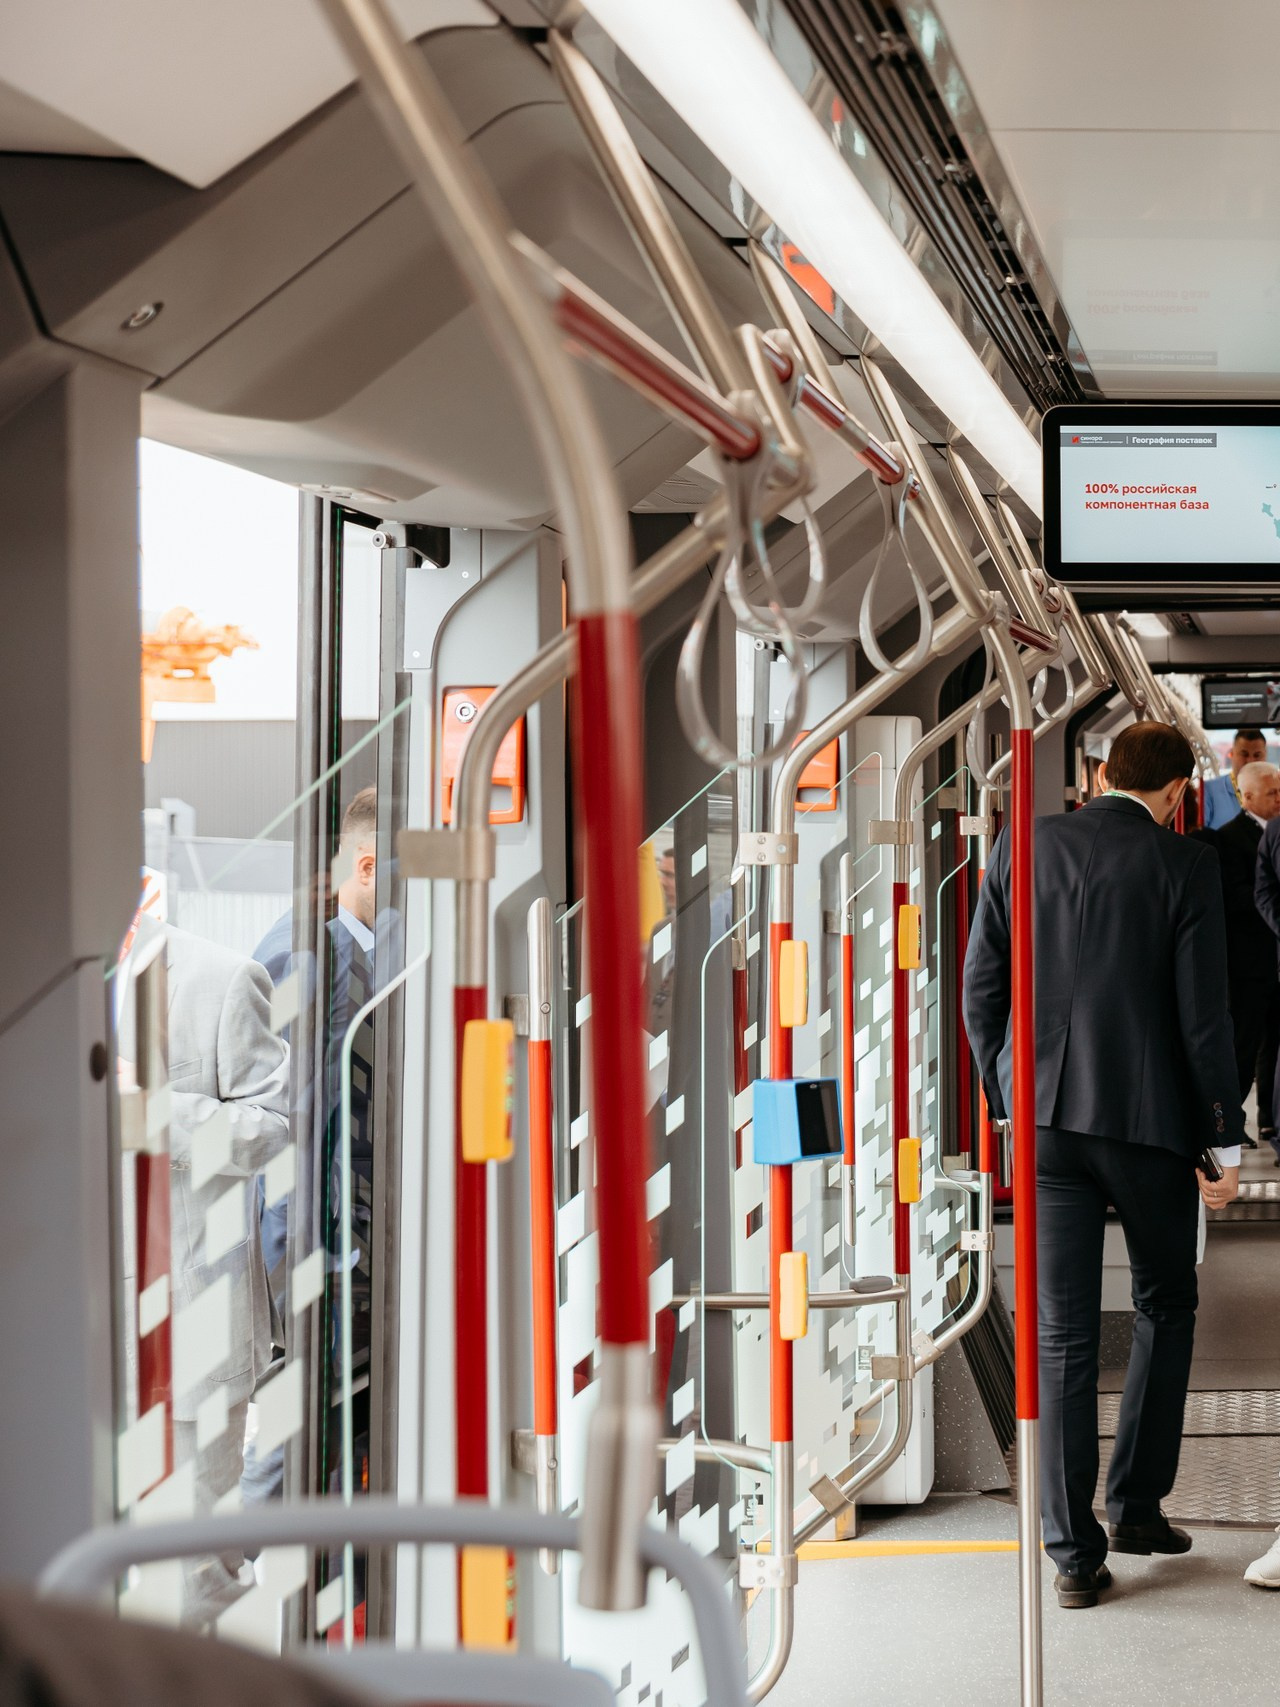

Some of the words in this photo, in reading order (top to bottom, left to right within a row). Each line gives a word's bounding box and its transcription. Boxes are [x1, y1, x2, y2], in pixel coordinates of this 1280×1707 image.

[1132, 436, 1174, 445] География
[1085, 484, 1119, 494] 100%
[1122, 484, 1197, 496] российская
[1085, 501, 1177, 510] компонентная
[1180, 500, 1209, 510] база
